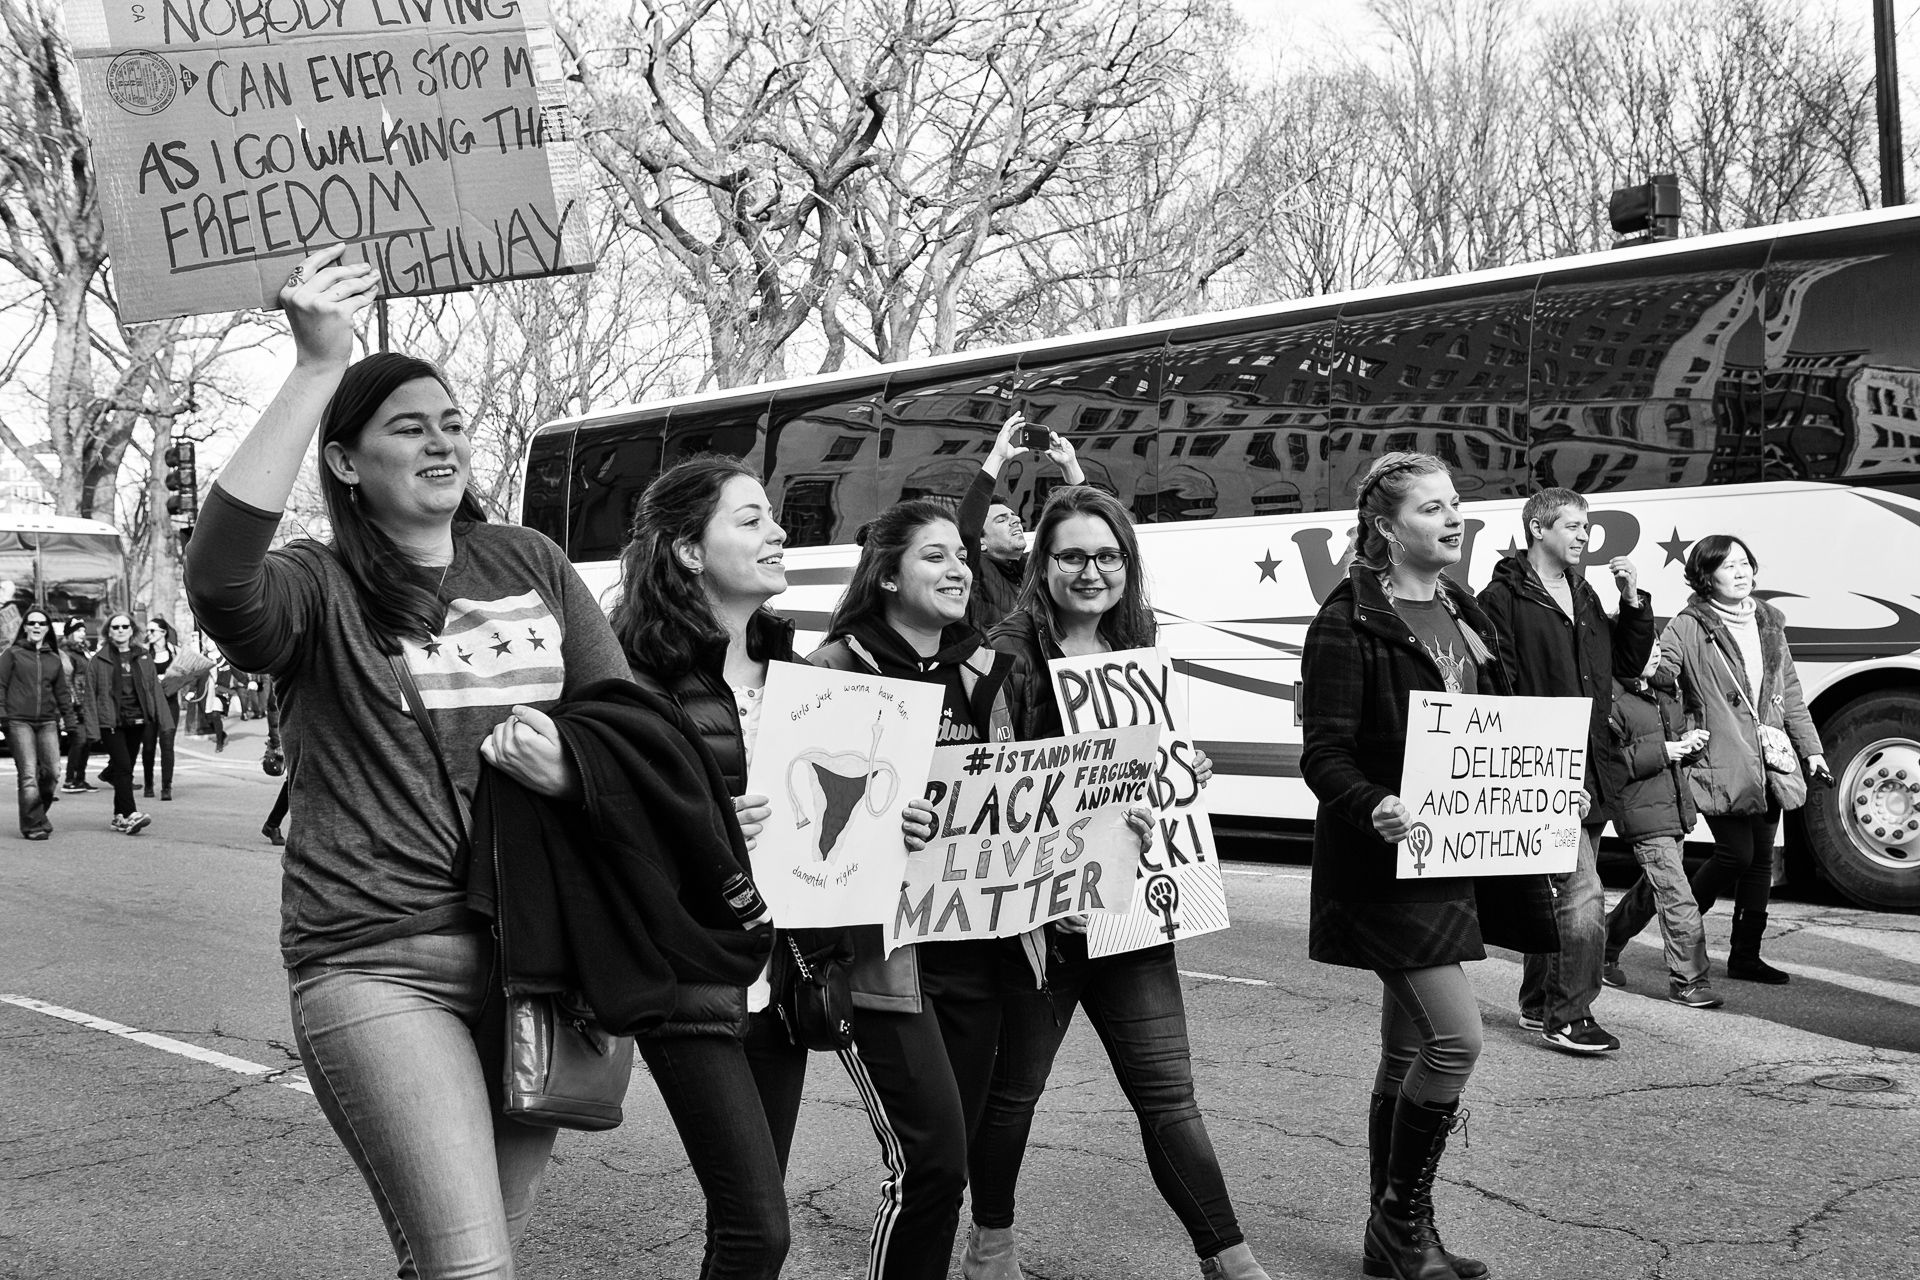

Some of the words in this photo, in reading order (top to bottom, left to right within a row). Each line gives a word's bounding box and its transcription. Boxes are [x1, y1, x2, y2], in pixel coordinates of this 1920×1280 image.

[163, 0, 346, 45] NOBODY
[376, 0, 522, 25] LIVING
[207, 58, 292, 117] CAN
[312, 50, 401, 104] EVER
[412, 43, 489, 97] STOP
[139, 140, 200, 195] AS
[210, 139, 227, 184] I
[234, 131, 296, 180] GO
[299, 118, 476, 171] WALKING
[160, 169, 433, 268] FREEDOM
[362, 199, 575, 300] IGHWAY
[790, 703, 810, 721] Girls
[816, 688, 833, 709] just
[843, 684, 870, 694] wanna
[878, 685, 894, 702] have
[1058, 661, 1175, 734] PUSSY
[1466, 707, 1502, 734] AM
[1074, 759, 1152, 788] FERGUSON
[1451, 745, 1584, 780] DELIBERATE
[924, 771, 1065, 843] BLACK
[1075, 785, 1112, 813] AND
[1111, 781, 1147, 803] NYC
[1418, 790, 1470, 816] AND
[1474, 787, 1548, 815] AFRAID
[1552, 789, 1581, 816] OF
[836, 863, 859, 887] rights
[893, 861, 1105, 940] MATTER
